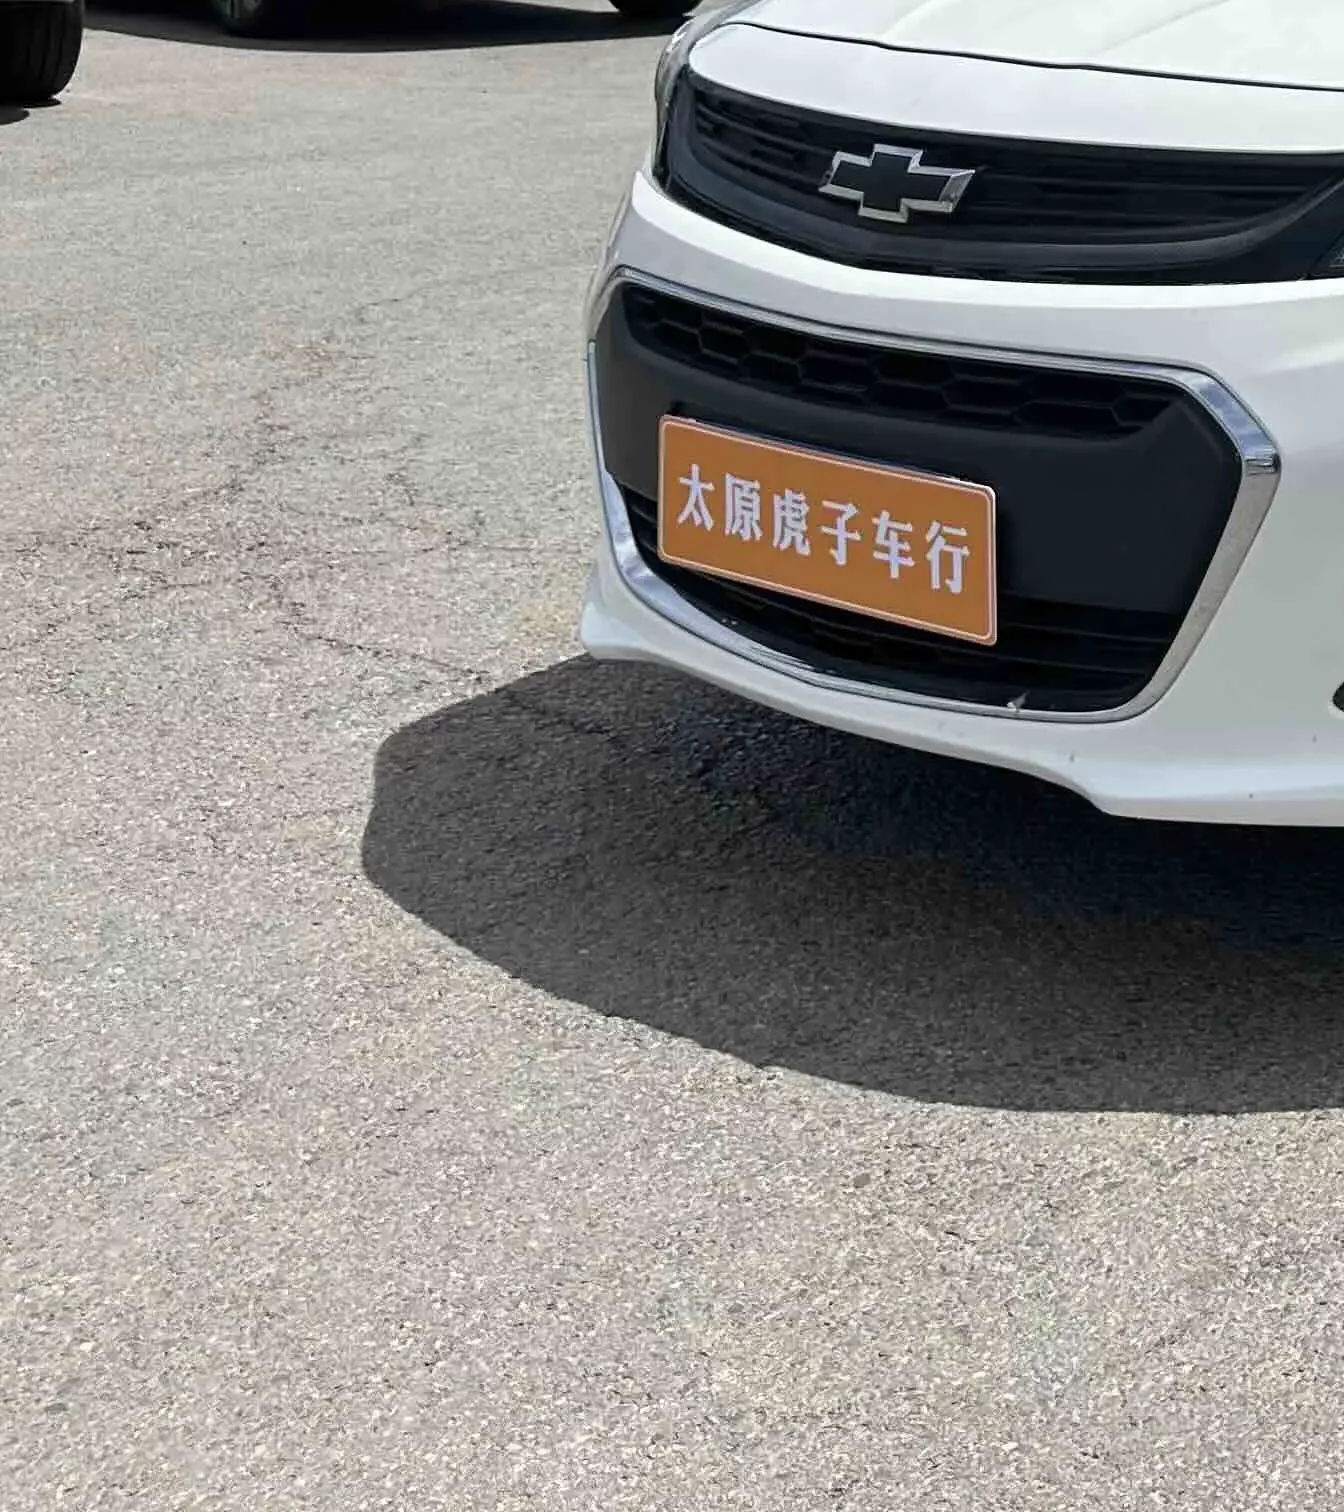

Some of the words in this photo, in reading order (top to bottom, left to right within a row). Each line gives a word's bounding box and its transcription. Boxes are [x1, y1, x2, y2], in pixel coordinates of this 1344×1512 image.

[677, 463, 970, 594] 太原虎子车行
